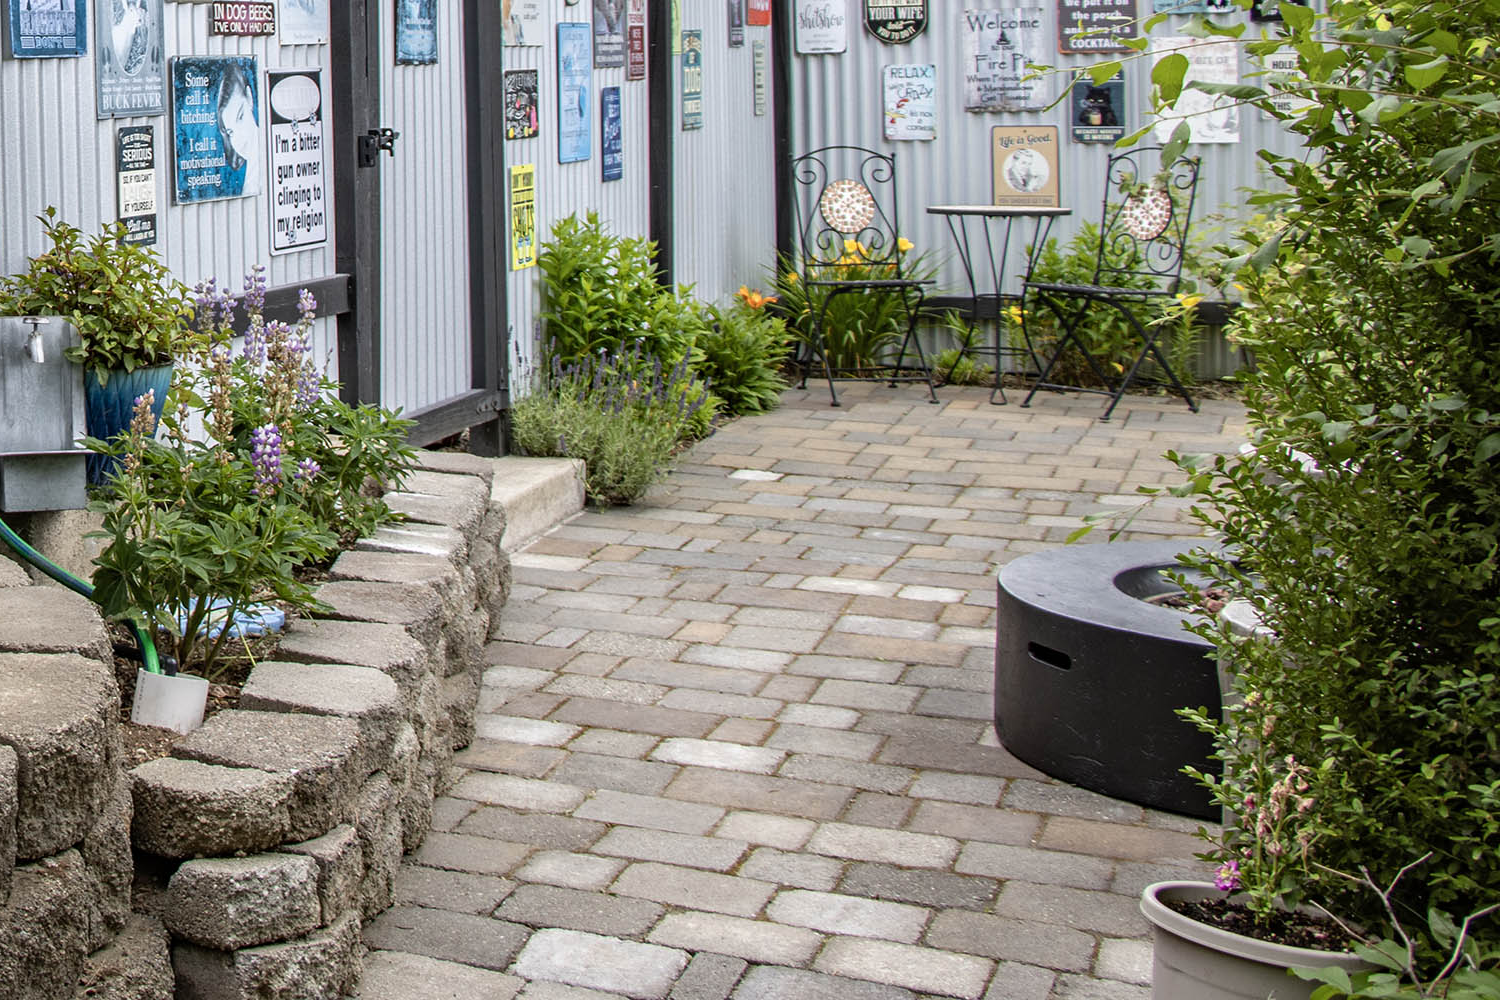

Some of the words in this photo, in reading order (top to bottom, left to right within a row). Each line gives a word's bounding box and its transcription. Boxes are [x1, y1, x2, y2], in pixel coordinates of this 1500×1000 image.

[214, 4, 224, 20] IN
[226, 4, 247, 20] DOG
[869, 7, 896, 20] YOUR
[897, 6, 924, 20] WIFE
[1072, 11, 1089, 19] the
[214, 21, 229, 33] I'VE
[230, 22, 248, 33] ONLY
[249, 22, 262, 33] HAD
[263, 22, 275, 33] ONE
[967, 13, 1039, 32] Welcome
[974, 54, 1008, 73] Fire
[1272, 60, 1292, 69] HOLD
[185, 72, 209, 87] Some
[103, 94, 130, 110] BUCK
[132, 92, 162, 108] FEVER
[186, 91, 200, 105] call
[202, 90, 209, 105] it
[190, 139, 194, 152] I
[195, 137, 209, 151] call
[210, 138, 217, 150] it
[276, 135, 289, 154] I'm
[292, 139, 297, 151] a
[299, 134, 320, 151] bitter
[999, 136, 1013, 148] Life
[1017, 136, 1024, 144] is
[122, 148, 152, 161] SERIOUS
[180, 153, 226, 170] motivational
[277, 164, 294, 184] gun
[296, 161, 320, 177] owner
[277, 185, 311, 208] clinging
[313, 184, 321, 200] to
[124, 203, 130, 212] AT
[131, 200, 153, 211] YOURSELF
[277, 217, 291, 232] my
[292, 209, 323, 232] religion
